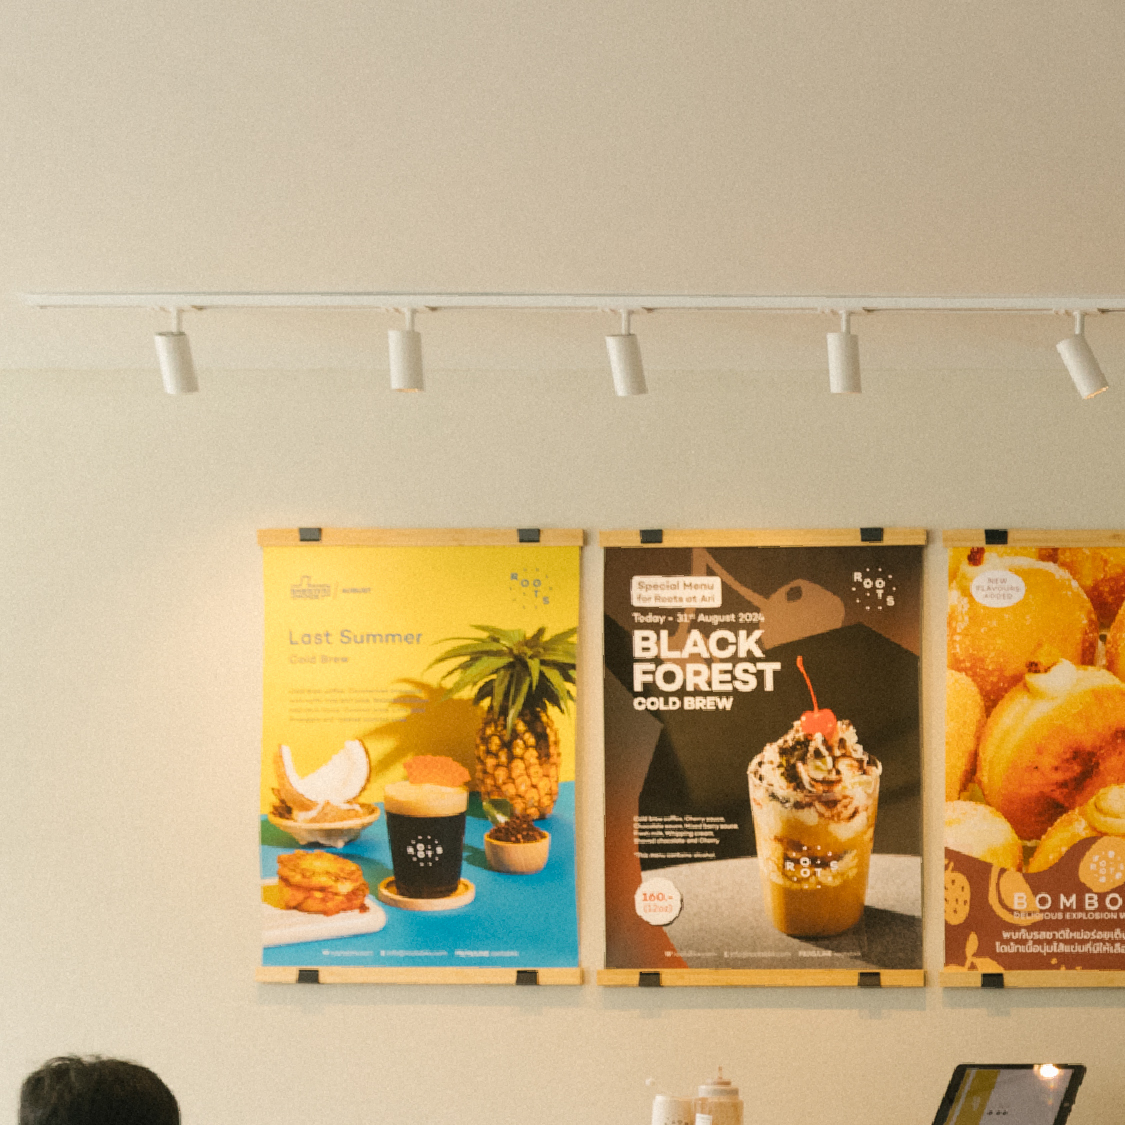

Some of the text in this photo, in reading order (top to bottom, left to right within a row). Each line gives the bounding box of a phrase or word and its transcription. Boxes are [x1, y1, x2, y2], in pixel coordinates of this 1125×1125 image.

[637, 581, 714, 592] Special Menu
[636, 594, 715, 603] for Roots at Ari
[632, 612, 666, 625] Today
[697, 612, 736, 625] August
[738, 612, 765, 624] 2024
[289, 629, 422, 645] Last Summer
[633, 629, 766, 659] BLACK
[633, 661, 781, 692] FOREST
[633, 696, 734, 711] COLD BREW
[1065, 911, 1118, 921] EXPLOSION
